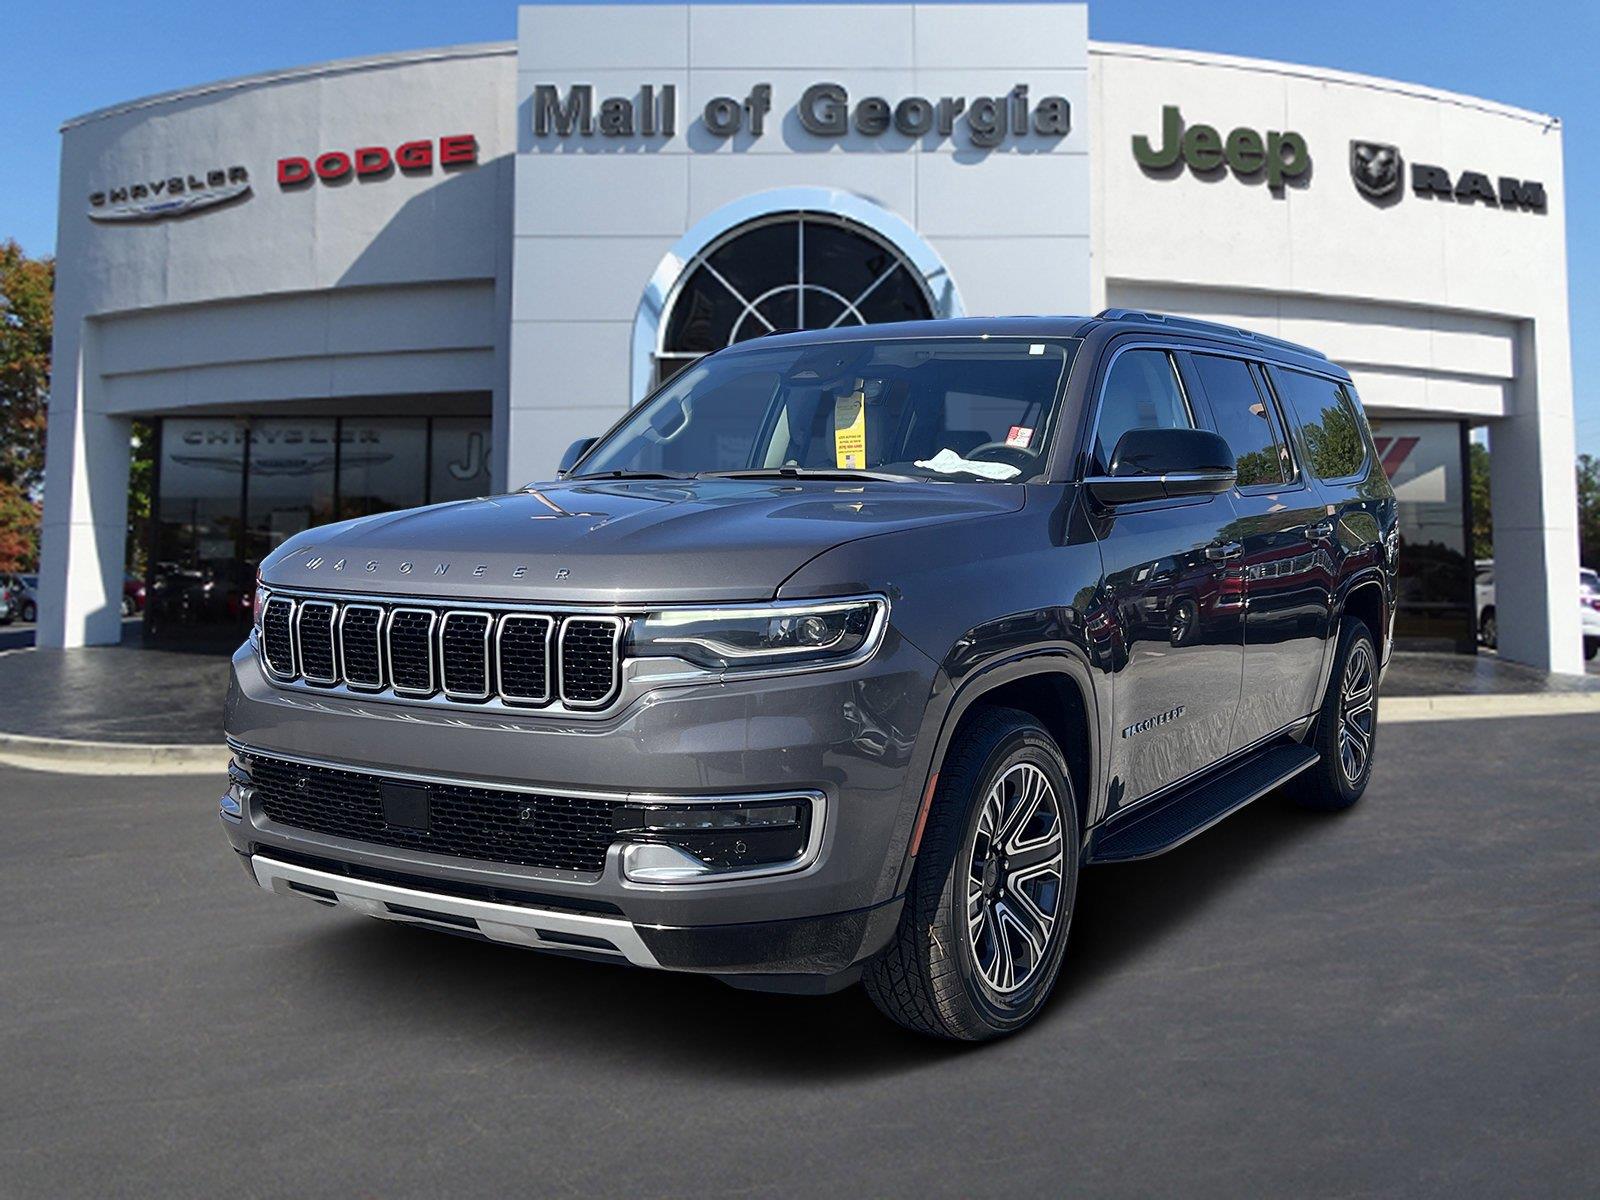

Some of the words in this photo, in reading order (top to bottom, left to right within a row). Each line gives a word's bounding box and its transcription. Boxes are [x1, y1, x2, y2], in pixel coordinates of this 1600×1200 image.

[532, 84, 676, 138] Mall
[703, 84, 772, 138] of
[799, 84, 1072, 149] Georgia
[276, 134, 477, 187] DODGE
[1131, 105, 1309, 192] Jeep
[89, 166, 248, 207] CHRYSLER
[1410, 162, 1547, 214] RAM
[306, 557, 571, 581] WAGONEER
